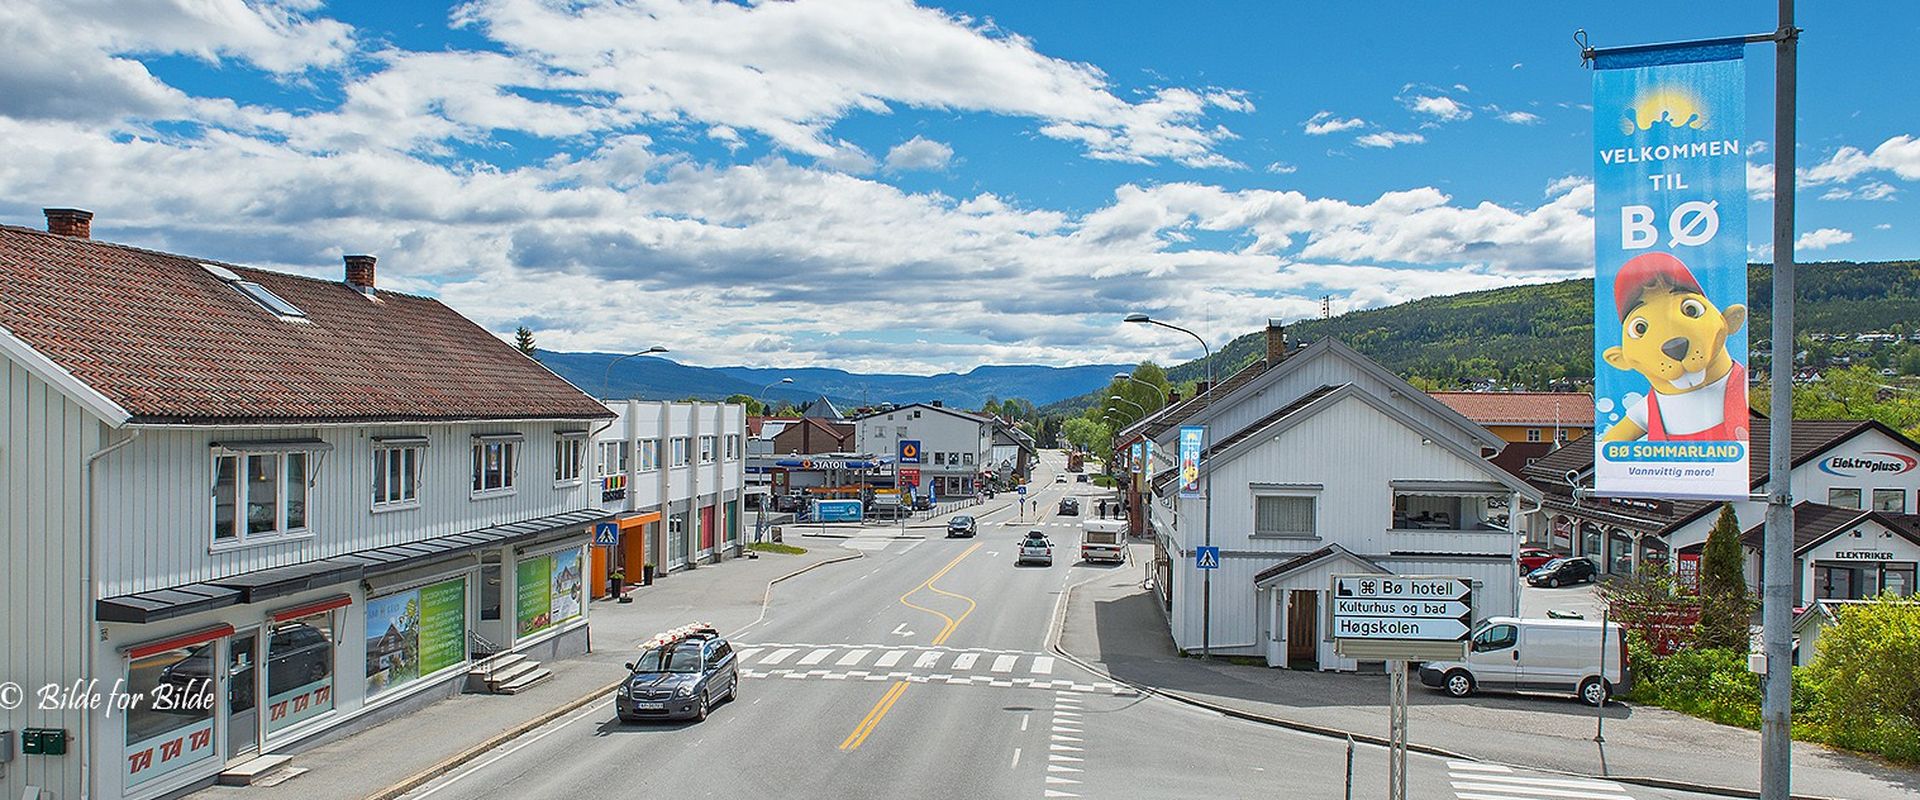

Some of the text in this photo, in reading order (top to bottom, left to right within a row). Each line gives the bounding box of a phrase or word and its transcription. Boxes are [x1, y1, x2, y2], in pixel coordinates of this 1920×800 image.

[1600, 140, 1739, 165] VELKOMMEN
[1648, 173, 1689, 191] TIL
[1621, 199, 1720, 250] BØ
[1608, 445, 1739, 458] BØ SOMMARLAND
[813, 461, 848, 470] STATOIL
[1628, 467, 1715, 478] Vannvittig moro!
[1835, 551, 1894, 560] ELEKTRIKER
[1382, 581, 1453, 596] Bø hotell
[1339, 601, 1447, 616] Kulturhus og bad
[1341, 619, 1419, 636] Høgskolen
[269, 685, 332, 723] TA TA TA
[128, 727, 212, 775] TA TA TA
